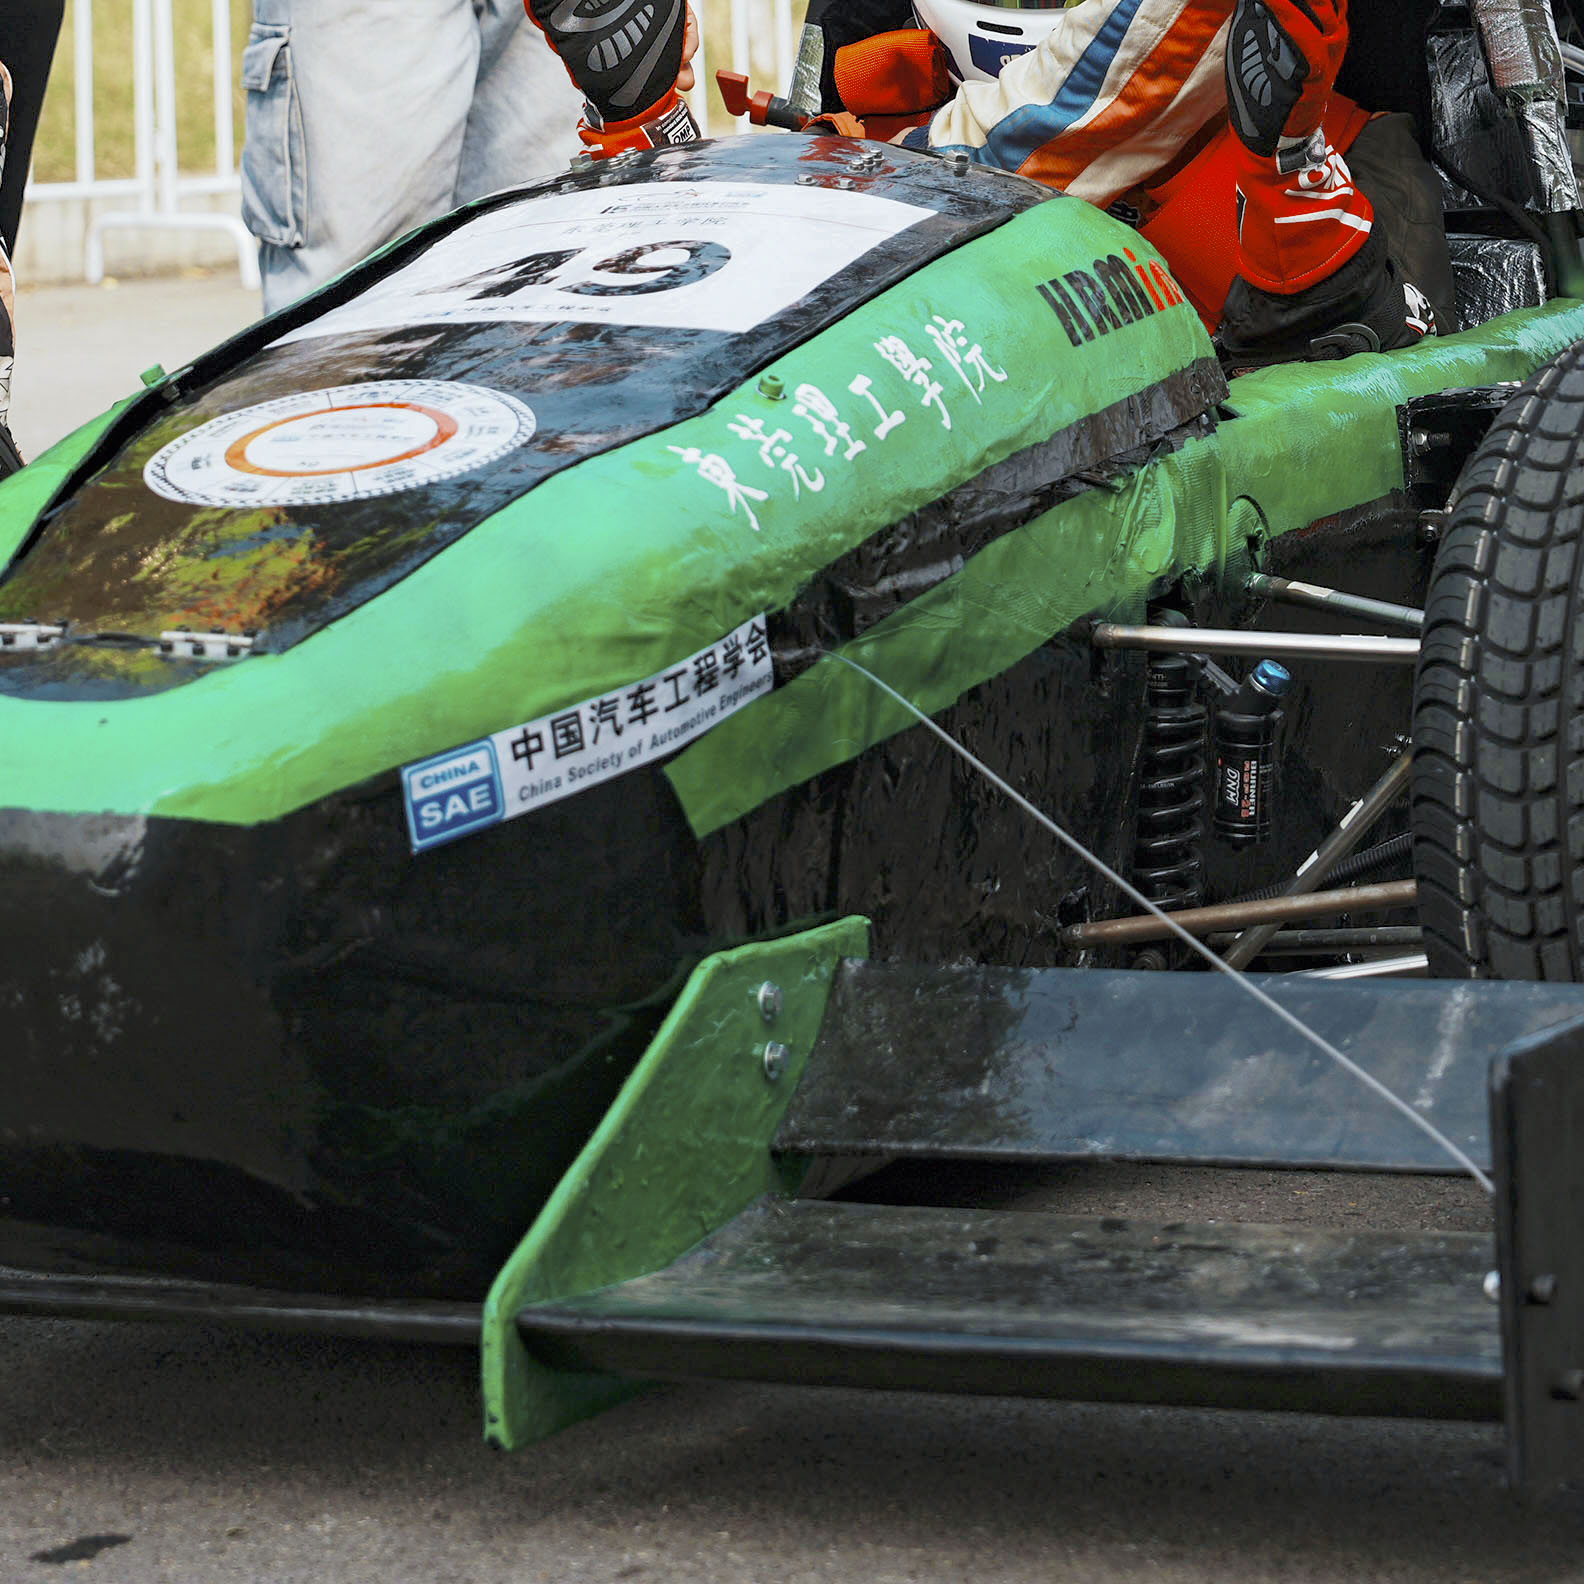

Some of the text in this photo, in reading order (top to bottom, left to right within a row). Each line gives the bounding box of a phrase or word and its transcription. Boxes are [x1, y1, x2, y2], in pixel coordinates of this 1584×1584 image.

[415, 239, 732, 301] 49
[510, 621, 771, 772] 中国汽车工程学会
[518, 670, 774, 803] China Society of Automotive Engineers
[419, 760, 481, 790] CHINA
[1226, 767, 1241, 806] DNM
[419, 783, 493, 830] SAE
